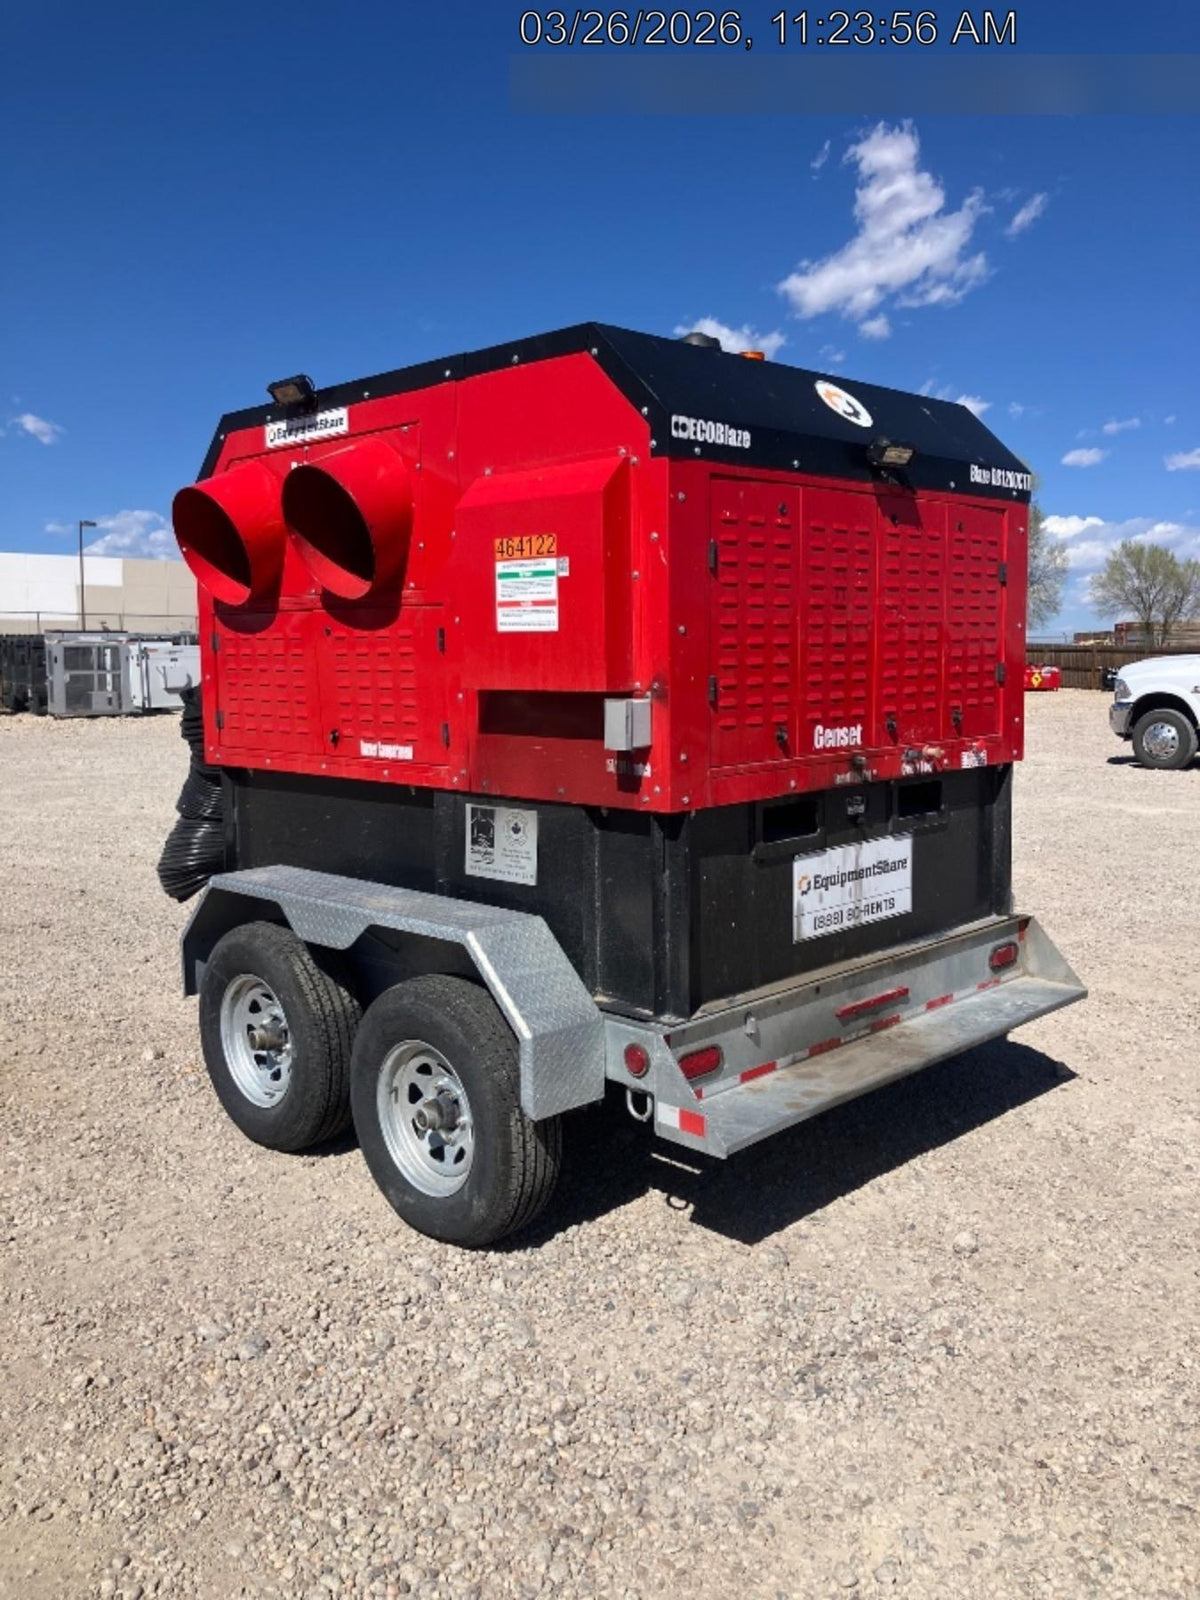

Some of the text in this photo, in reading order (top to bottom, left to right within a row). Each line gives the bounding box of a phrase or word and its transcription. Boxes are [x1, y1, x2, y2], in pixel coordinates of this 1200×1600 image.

[689, 417, 752, 449] ECOBlaze
[497, 534, 556, 558] 464122
[813, 724, 863, 749] Genset
[813, 858, 909, 892] EquipmentShare
